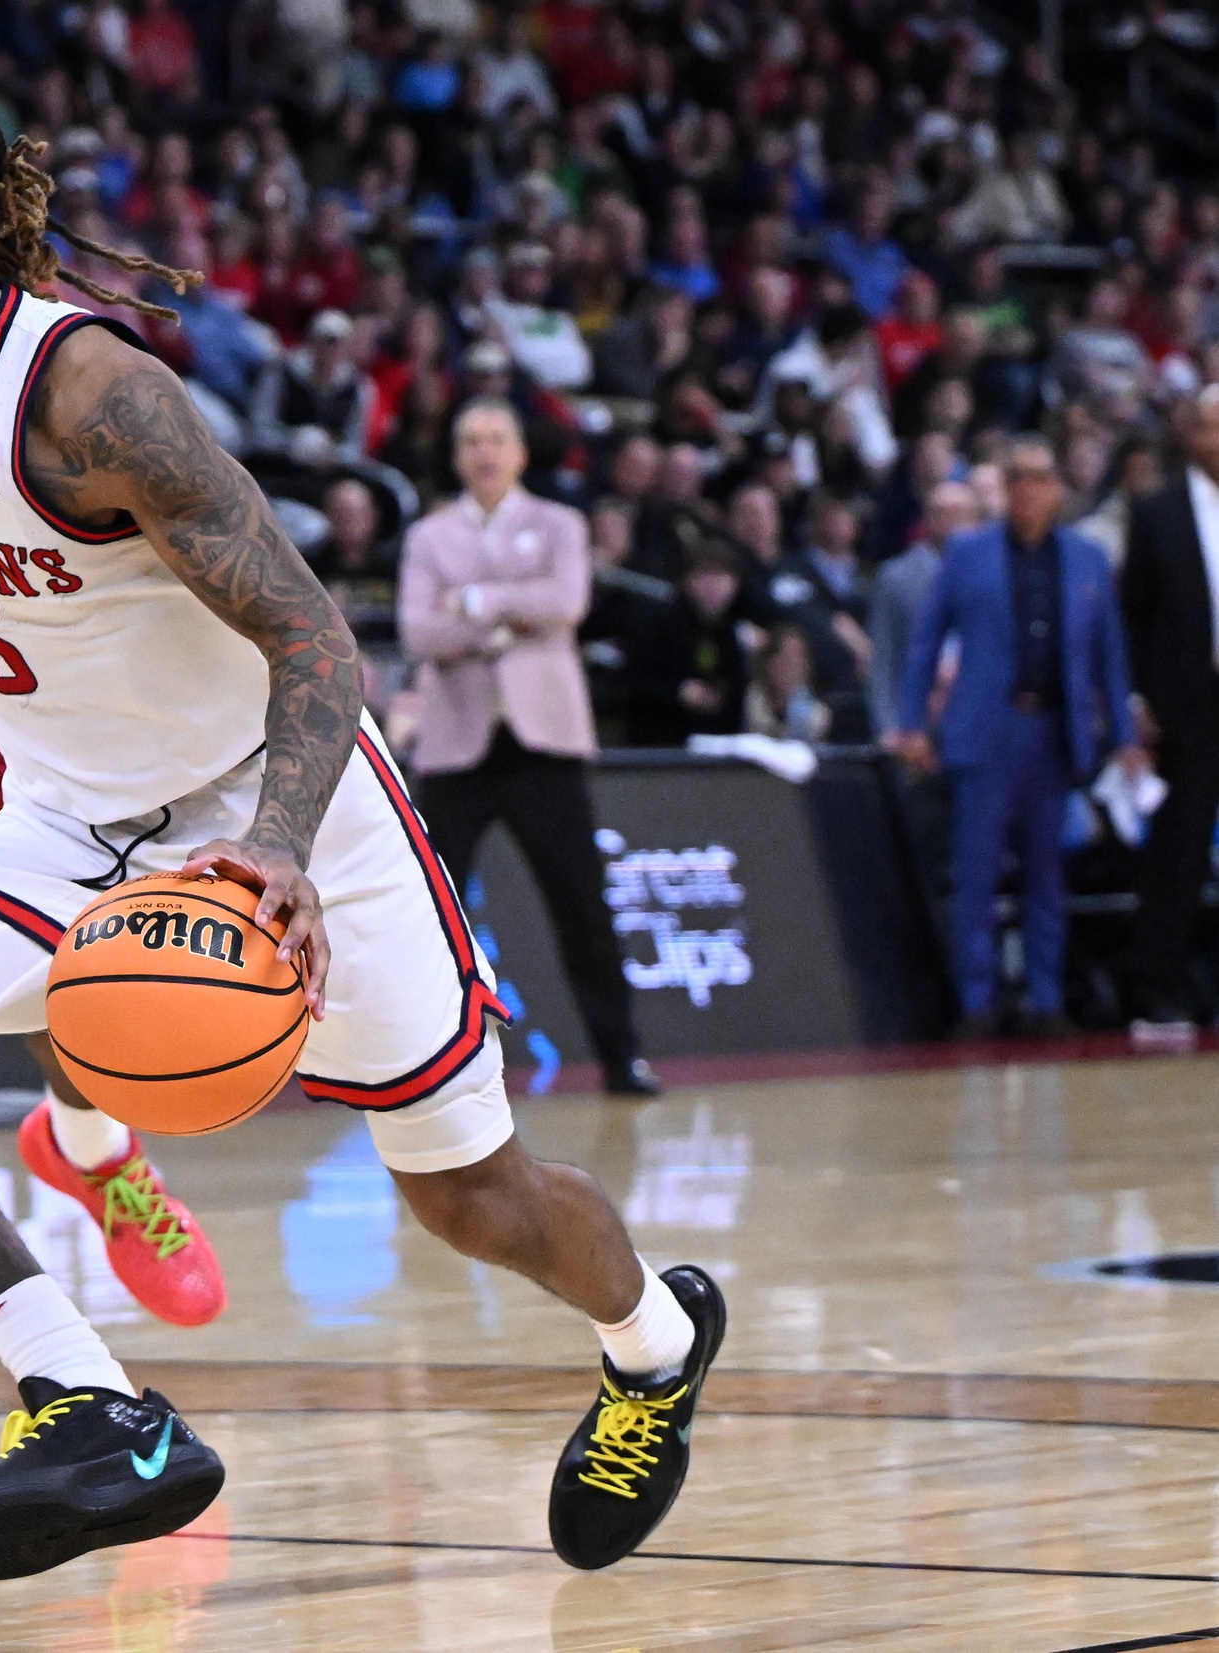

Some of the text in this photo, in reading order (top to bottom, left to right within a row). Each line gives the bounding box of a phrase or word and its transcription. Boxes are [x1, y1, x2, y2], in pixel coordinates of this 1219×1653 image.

[126, 902, 183, 910] EVO NXT
[73, 910, 246, 970] Wilson
